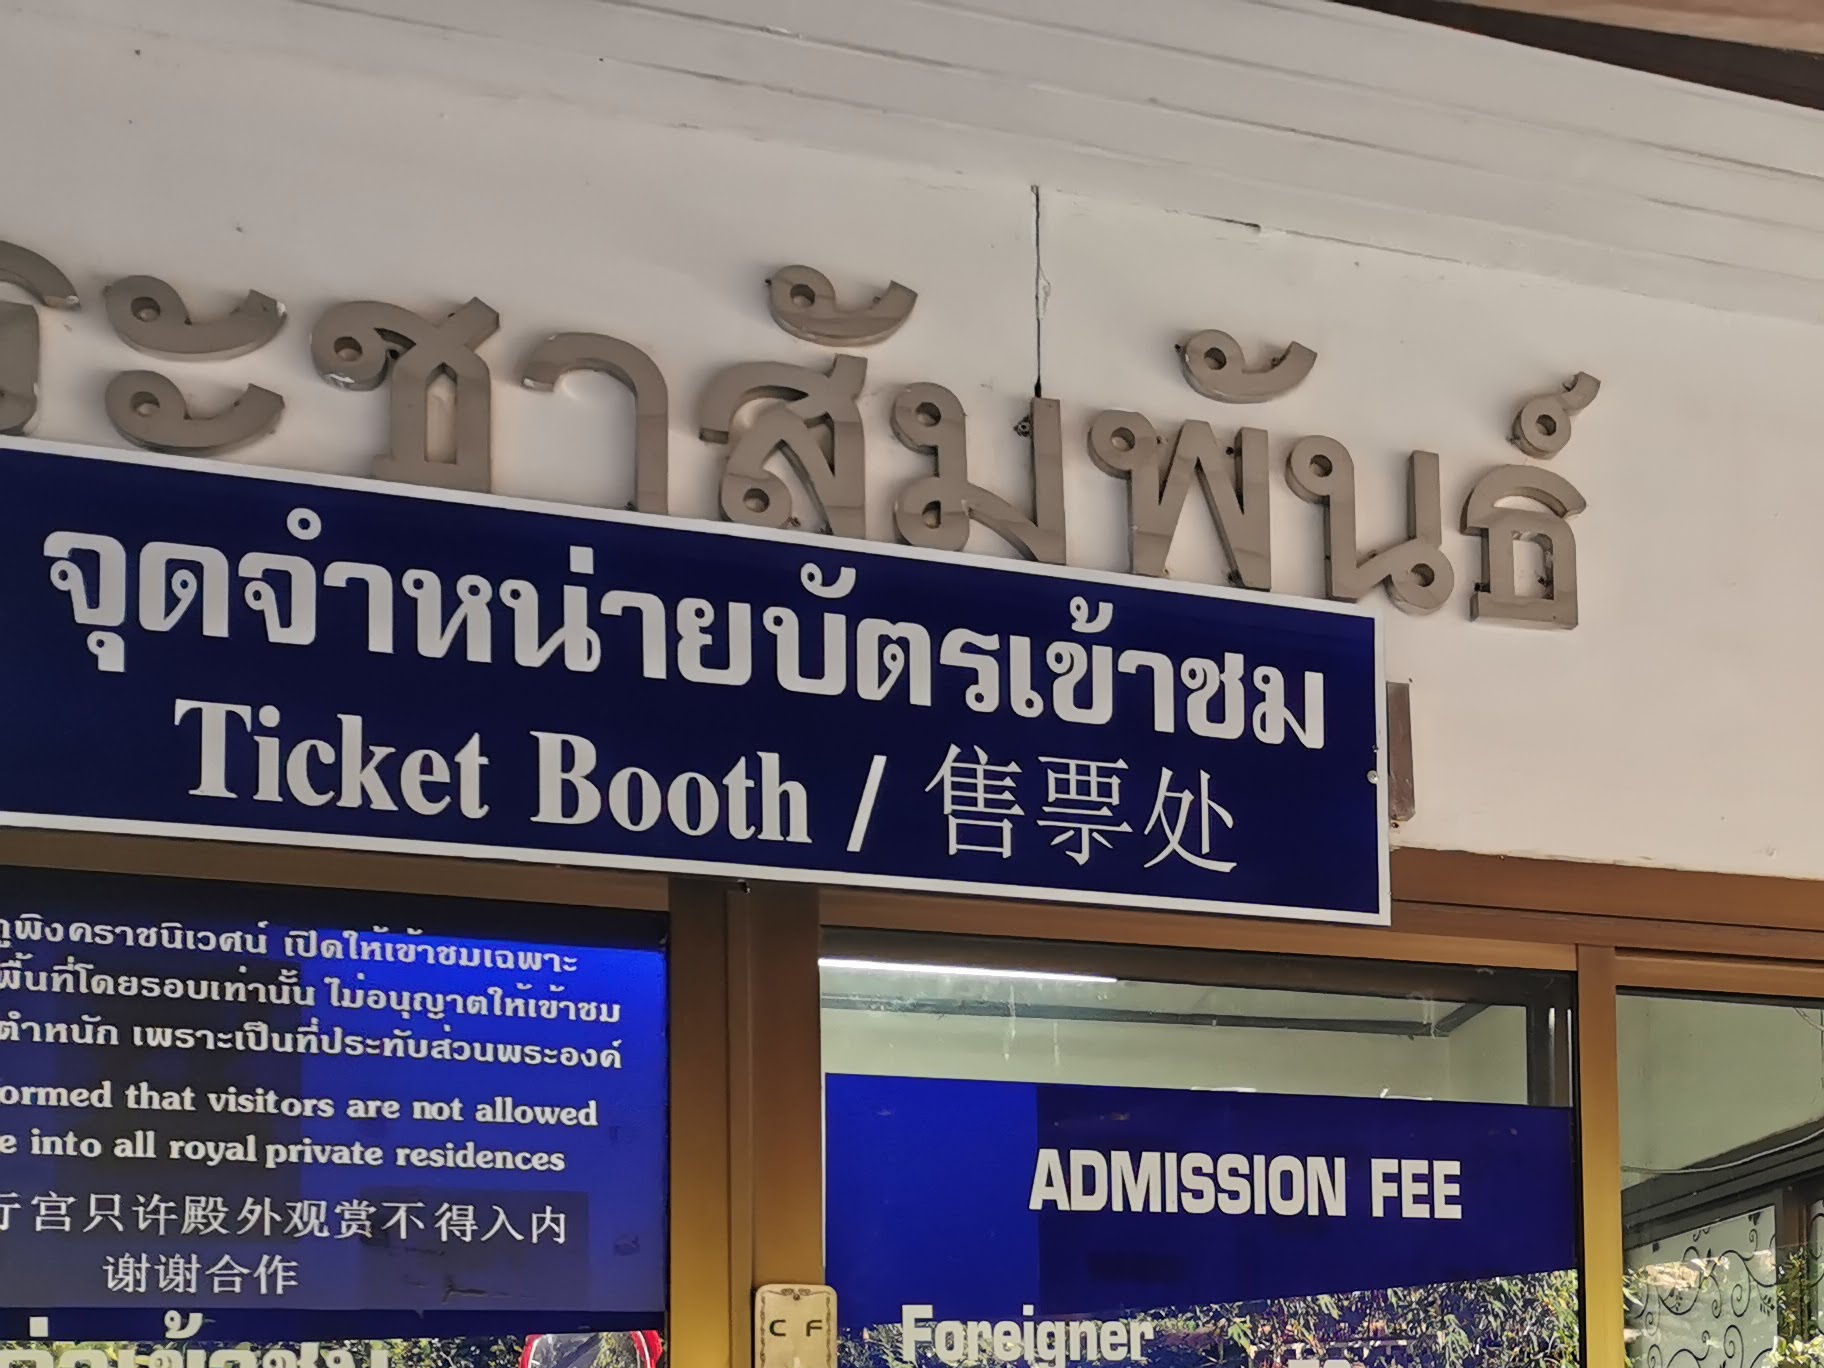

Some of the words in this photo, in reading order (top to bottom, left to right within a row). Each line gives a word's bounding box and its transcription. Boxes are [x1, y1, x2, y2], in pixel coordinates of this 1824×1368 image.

[43, 507, 1325, 750] จุดจำหน่ายบัตรเข้าชม
[174, 698, 489, 820] Ticket
[529, 729, 812, 845] Booth
[846, 755, 887, 853] /
[925, 743, 1237, 873] 售票处
[284, 924, 577, 974] เปิดให้เข้าชมเฉพาะ
[0, 951, 315, 1007] พื้นที่โดยรอบเท่านั้น
[324, 973, 620, 1024] ไม่อนุญาตให้เข้าชม
[0, 1010, 119, 1046] ตำหนัก
[133, 1018, 622, 1070] เพราะเป็นที่ประทับส่วนพระองค์
[0, 1080, 113, 1108] ormed
[125, 1081, 195, 1112] that
[209, 1085, 334, 1118] visitors
[346, 1099, 400, 1120] are
[412, 1098, 463, 1122] not
[475, 1097, 598, 1127] allowed
[31, 1128, 102, 1157] into
[113, 1130, 156, 1158] all
[169, 1132, 257, 1168] royal
[265, 1136, 383, 1170] private
[395, 1141, 566, 1172] residences
[1029, 1148, 1347, 1218] ADMISSION
[1371, 1158, 1463, 1219] FEE
[103, 1252, 300, 1296] 谢谢合作
[769, 1319, 787, 1338] C
[806, 1319, 823, 1337] F
